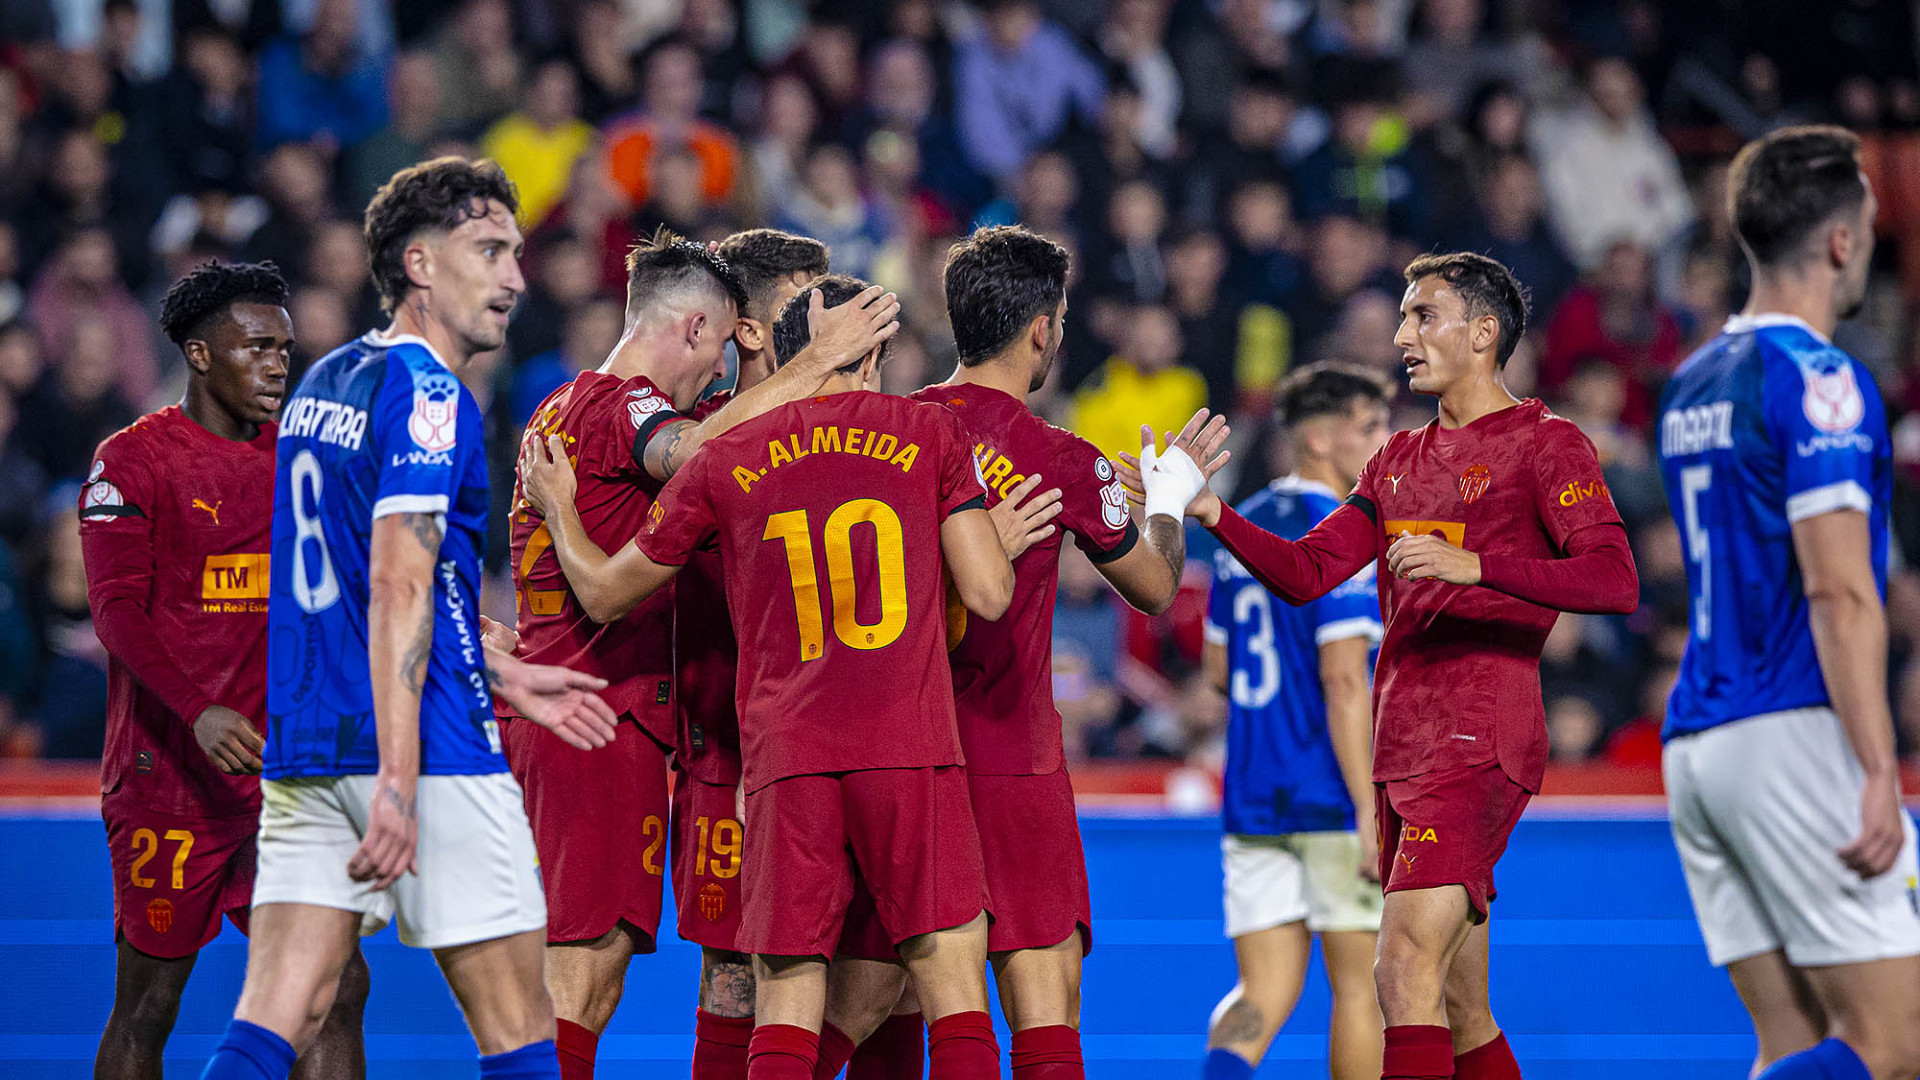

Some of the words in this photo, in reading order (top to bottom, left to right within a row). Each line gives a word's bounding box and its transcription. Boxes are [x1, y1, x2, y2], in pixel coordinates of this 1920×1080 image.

[768, 426, 921, 474] ALMEIDA
[211, 566, 249, 590] TM
[223, 601, 247, 613] Real
[761, 497, 910, 664] 10
[1231, 583, 1281, 710] 3
[130, 827, 195, 890] 27
[642, 814, 664, 876] 2
[695, 815, 743, 879] 19
